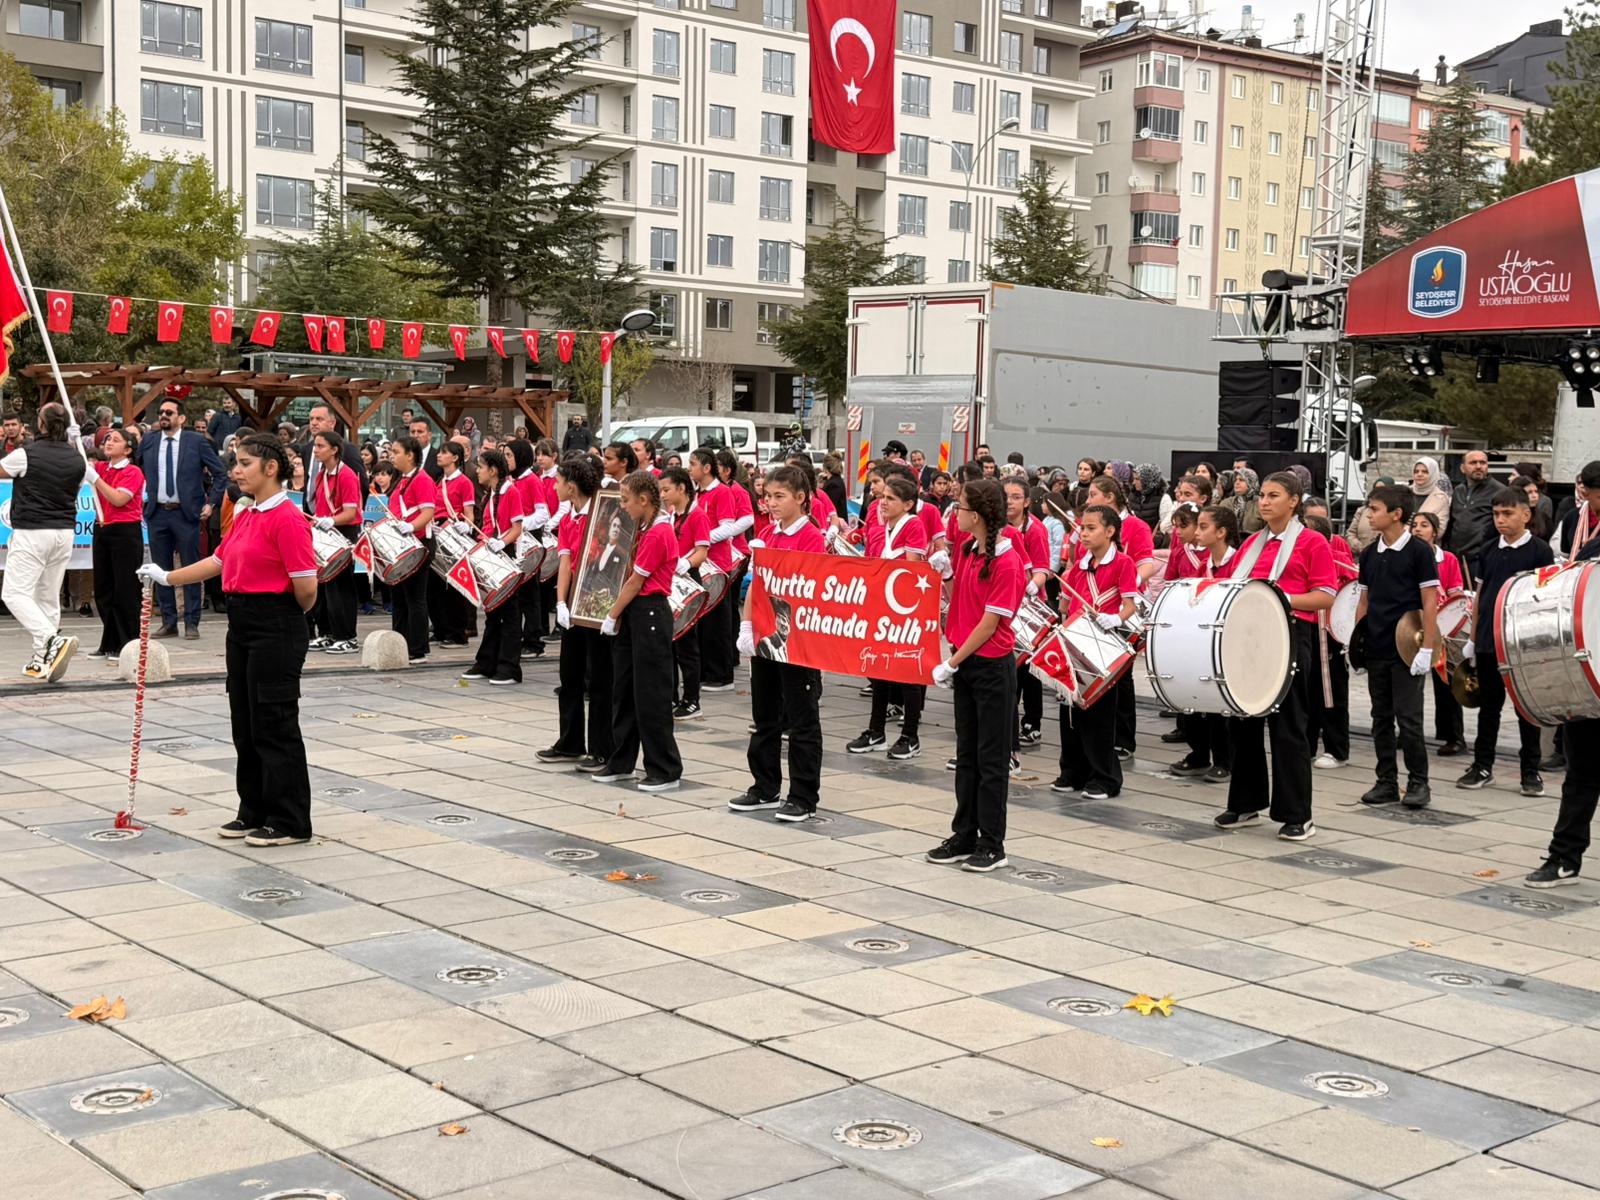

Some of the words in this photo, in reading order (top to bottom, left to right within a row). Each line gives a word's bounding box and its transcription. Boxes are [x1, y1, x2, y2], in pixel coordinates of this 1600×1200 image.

[1498, 250, 1554, 275] Hasan
[1415, 290, 1457, 300] SEYDİŞEHİR
[1480, 272, 1571, 297] USTAOĞLU
[1415, 298, 1456, 308] BELEDİYESİ
[1479, 297, 1512, 307] SEYDİŞEHİR
[1512, 295, 1542, 305] BELEDİYE
[821, 575, 868, 605] Sulh
[795, 605, 869, 639] Cihanda
